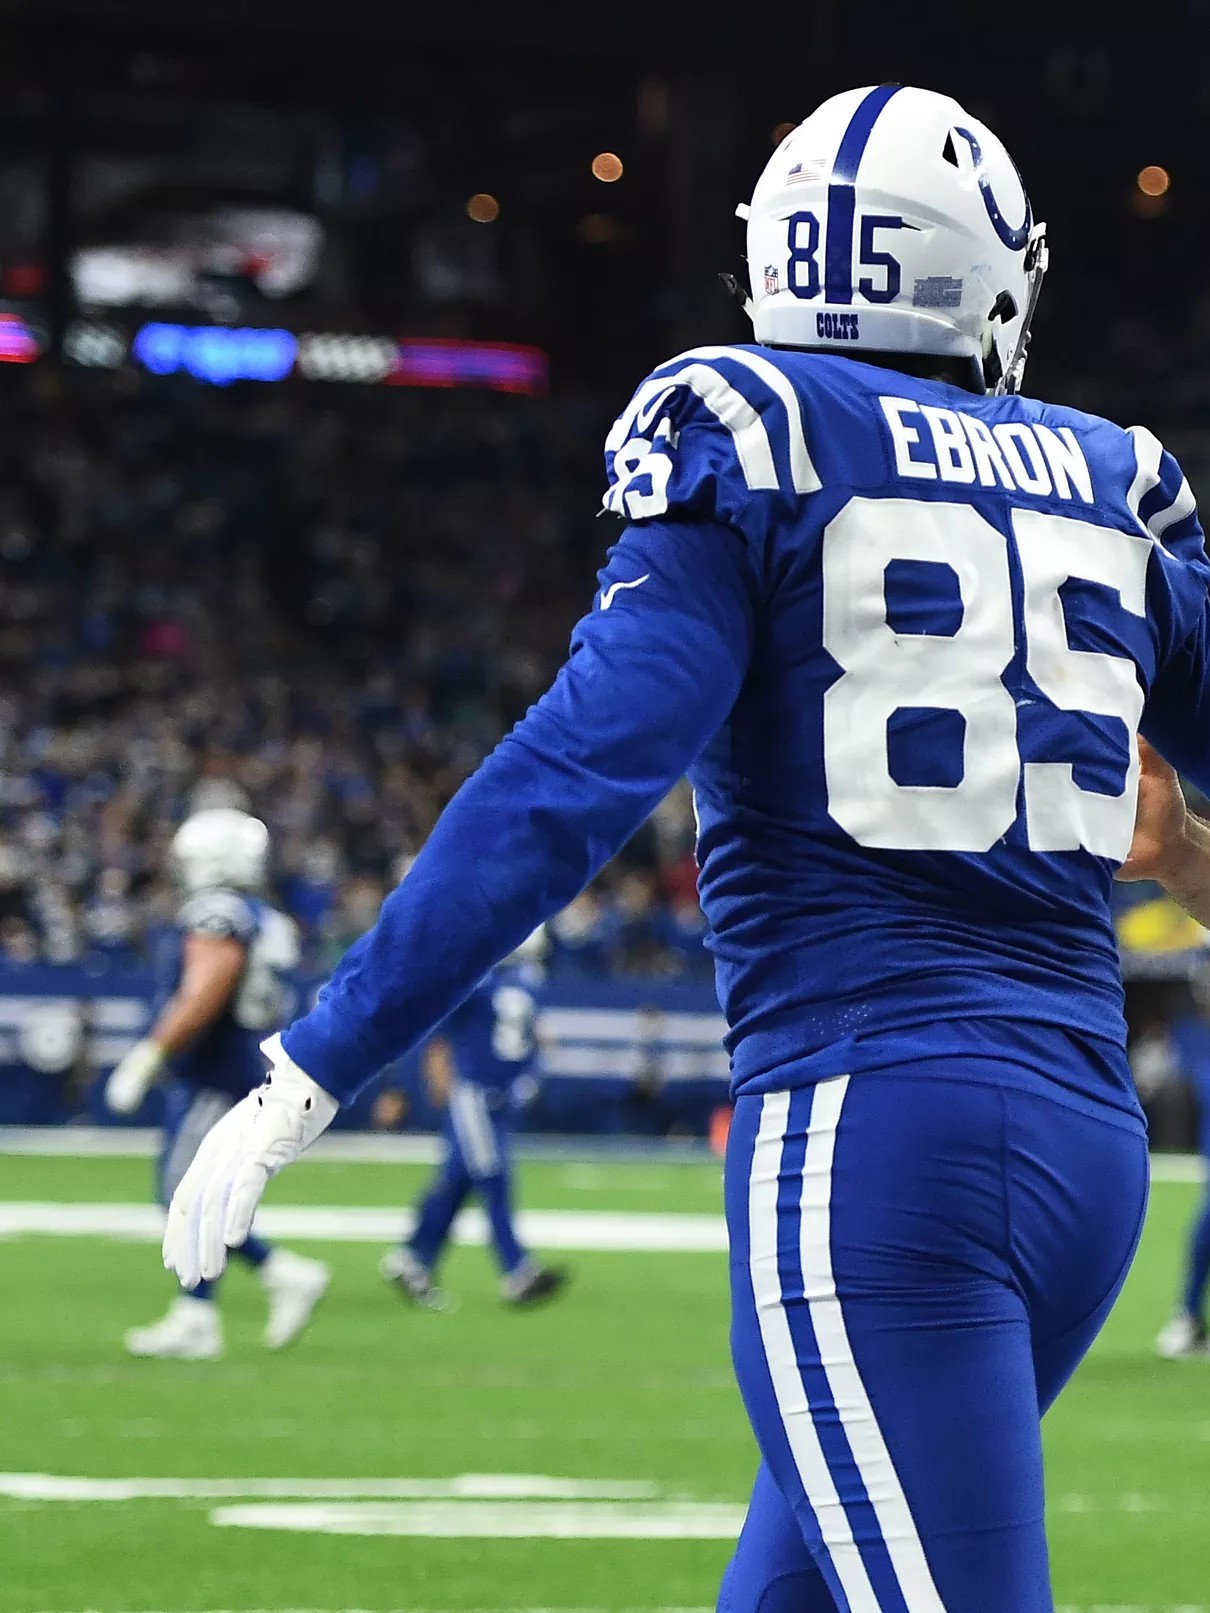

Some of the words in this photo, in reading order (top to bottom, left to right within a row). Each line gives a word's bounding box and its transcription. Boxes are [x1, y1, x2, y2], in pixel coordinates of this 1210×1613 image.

[816, 312, 859, 340] COLTS
[878, 396, 1094, 504] EBRON
[823, 496, 1153, 864] 85
